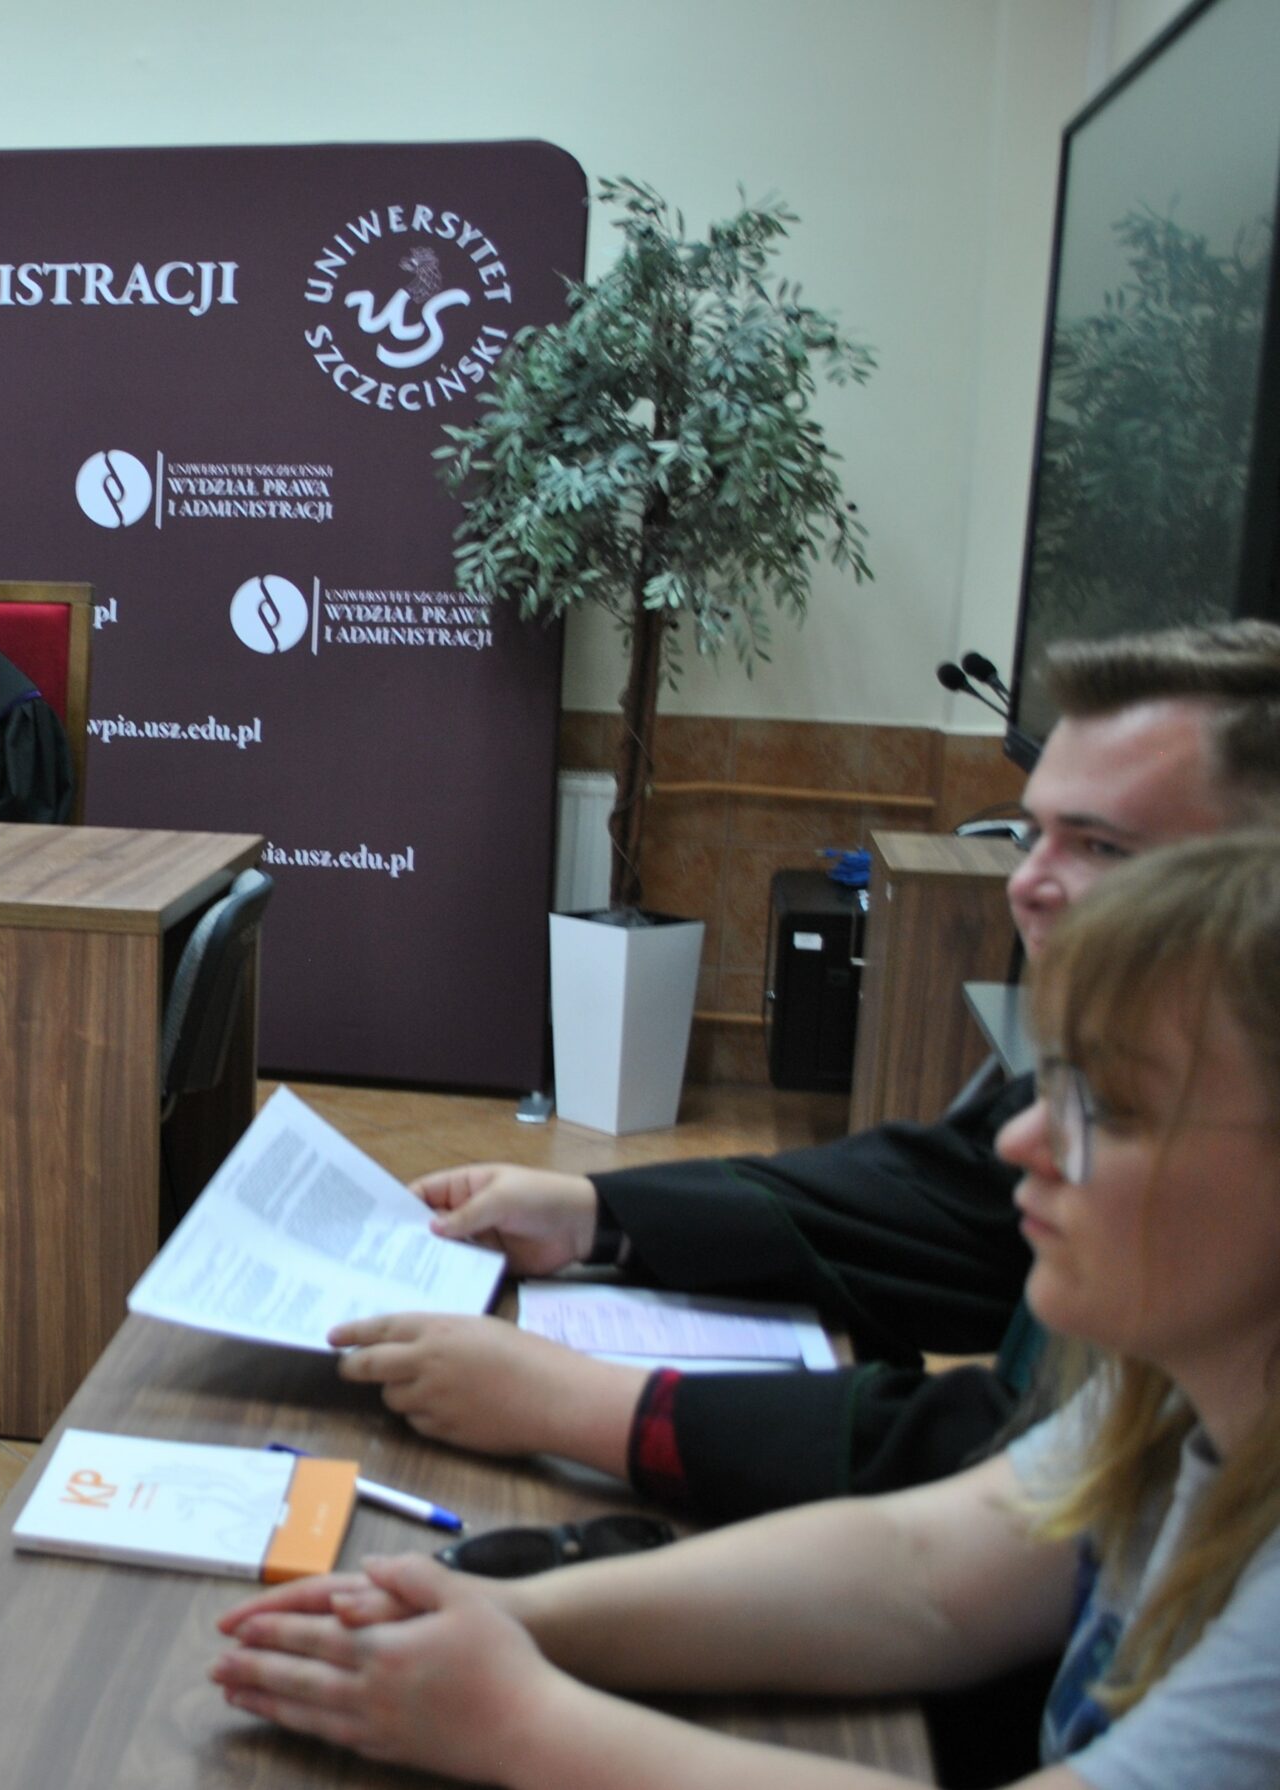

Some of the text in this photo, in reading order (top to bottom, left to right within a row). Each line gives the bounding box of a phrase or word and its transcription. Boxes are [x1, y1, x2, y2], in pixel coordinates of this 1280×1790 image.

[304, 204, 512, 304] UNIWERSYTET
[304, 324, 508, 412] SZCZECIŃSKI
[167, 477, 330, 497] WYDZIAŁ PRAWA
[168, 499, 333, 523] I ADMINISTRACJI
[324, 603, 489, 625] WYDZIAŁ PRAWA
[324, 625, 493, 651] I ADMINISTRACJI
[86, 713, 263, 750] wpia.usz.edu.pl
[261, 841, 416, 879] ia.usz.edu.pl
[58, 1467, 119, 1510] KP
